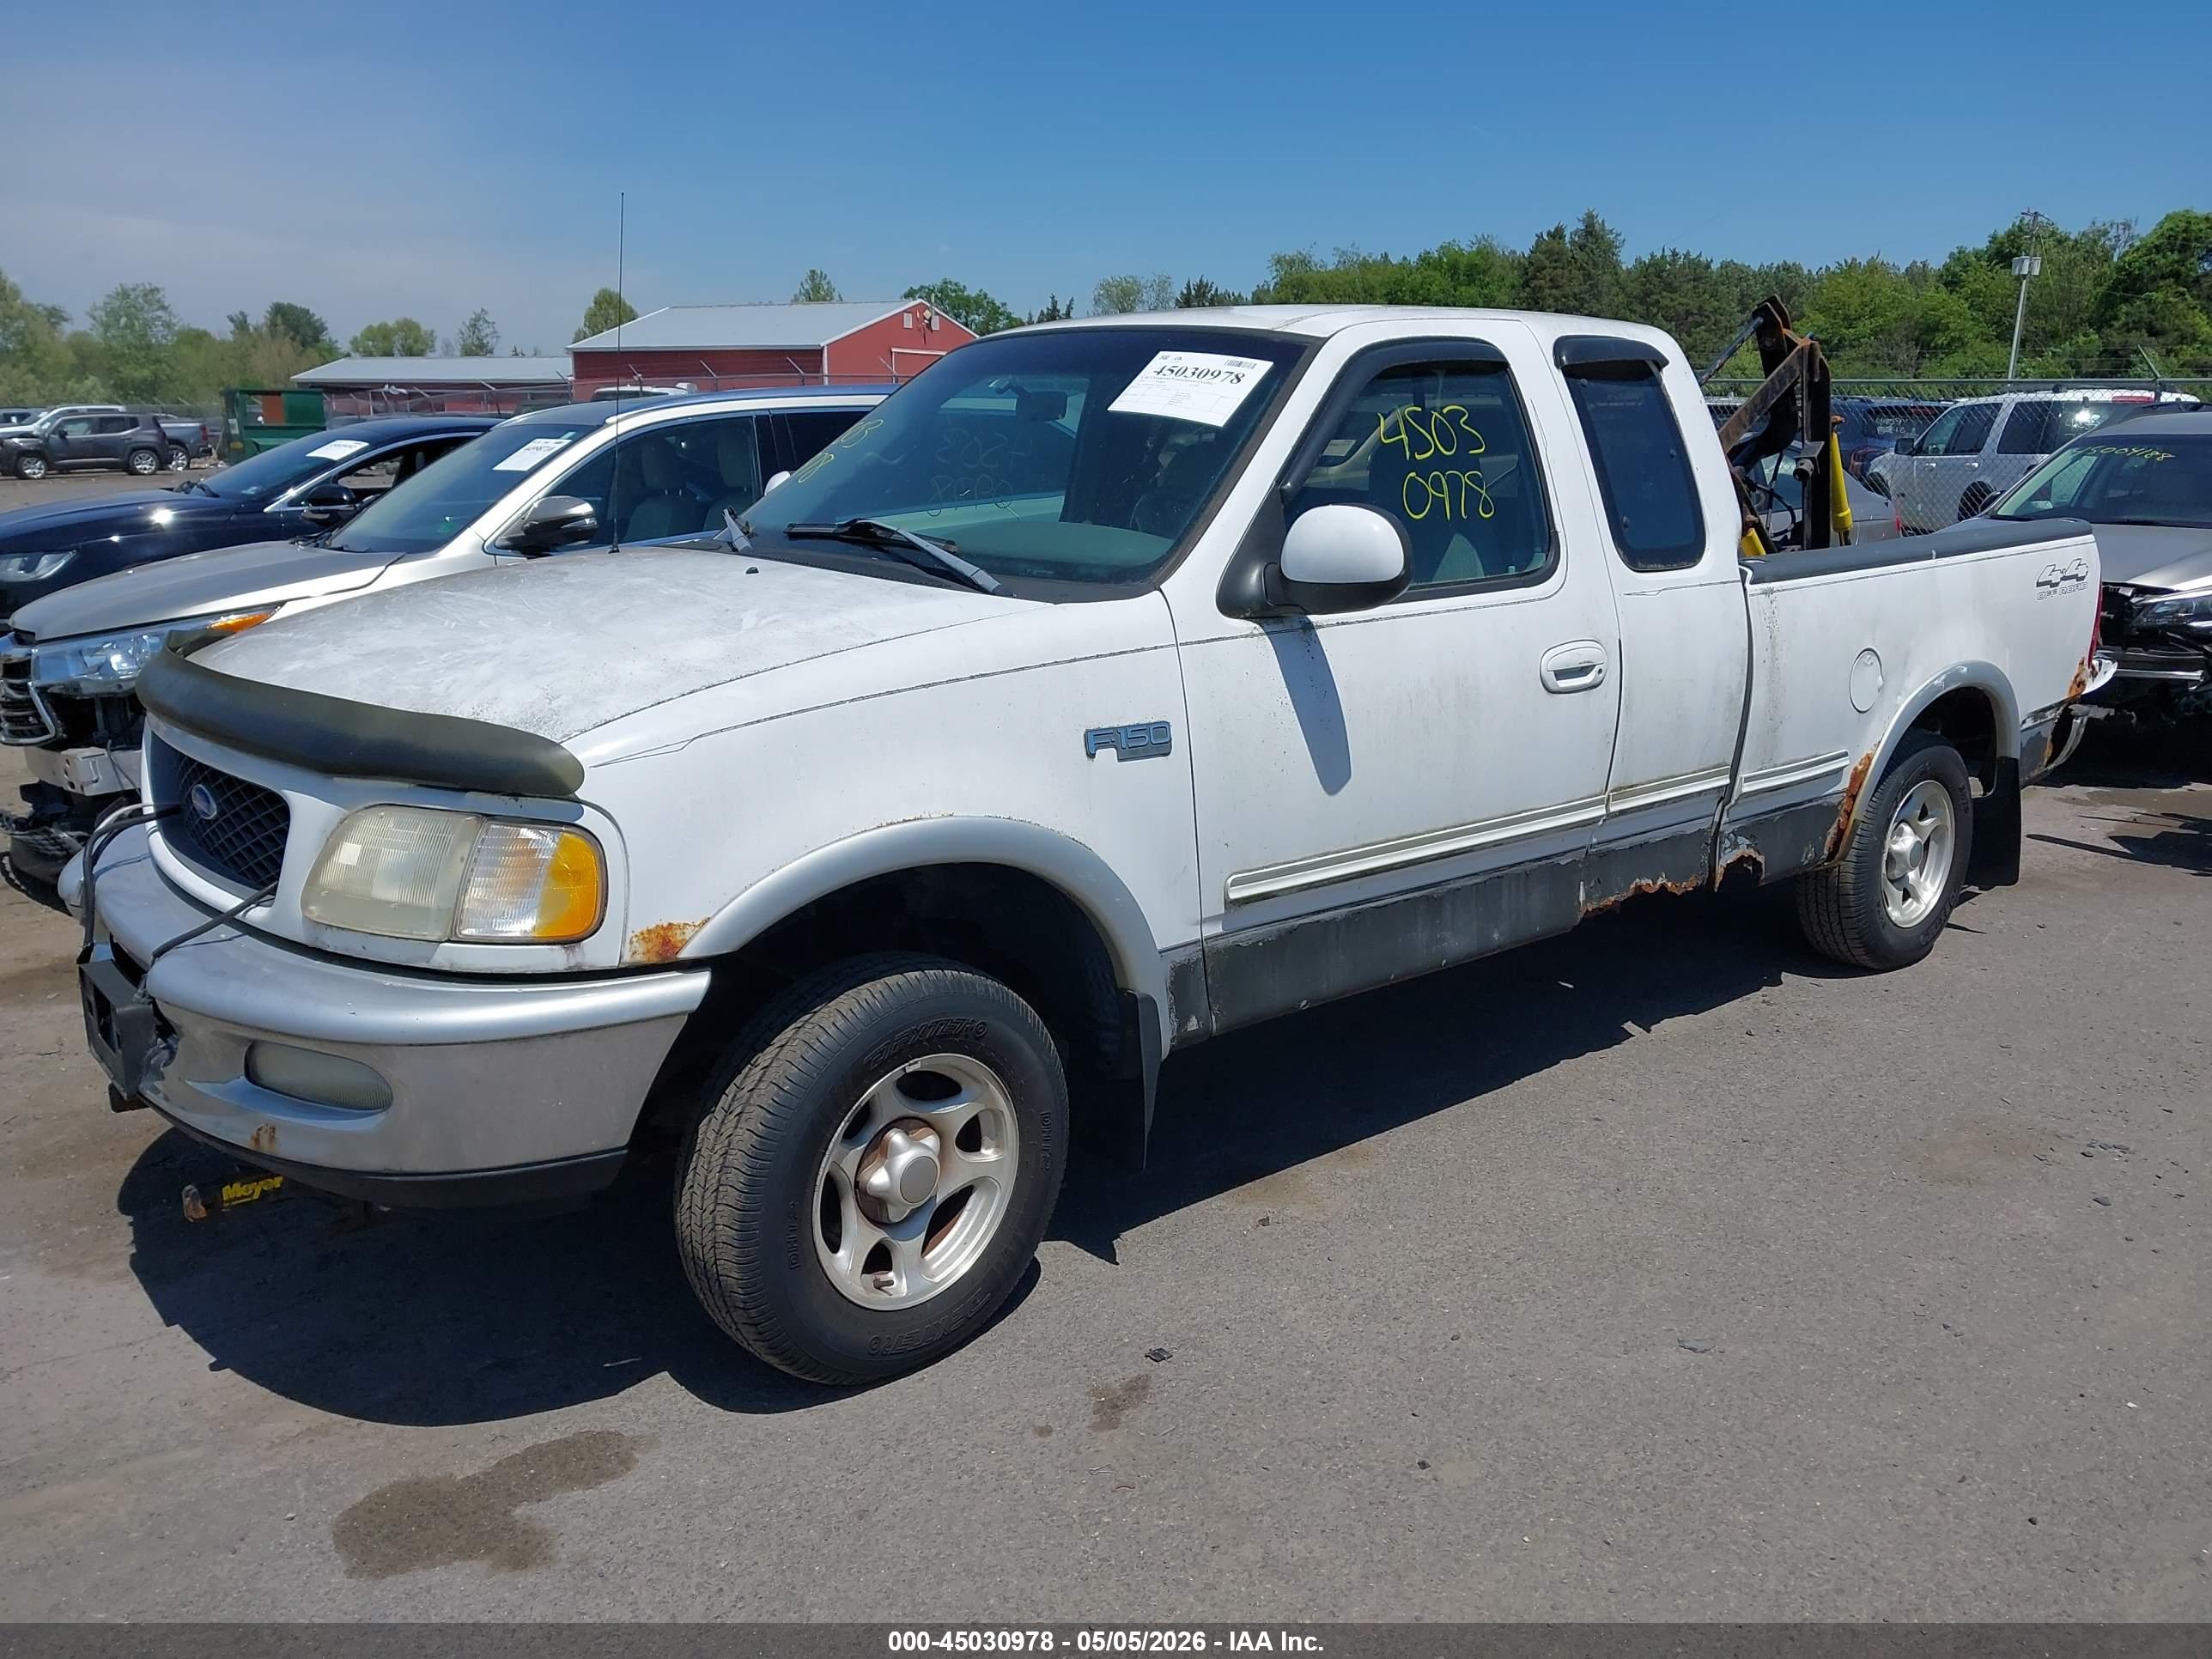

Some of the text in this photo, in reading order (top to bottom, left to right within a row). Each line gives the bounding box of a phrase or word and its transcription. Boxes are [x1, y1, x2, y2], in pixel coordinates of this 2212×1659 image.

[1153, 364, 1246, 385] 45030978
[1377, 404, 1486, 460] 4503
[1403, 471, 1494, 520] 0978
[2036, 582, 2087, 601] OFF ROAD
[222, 1175, 283, 1201] Meyer
